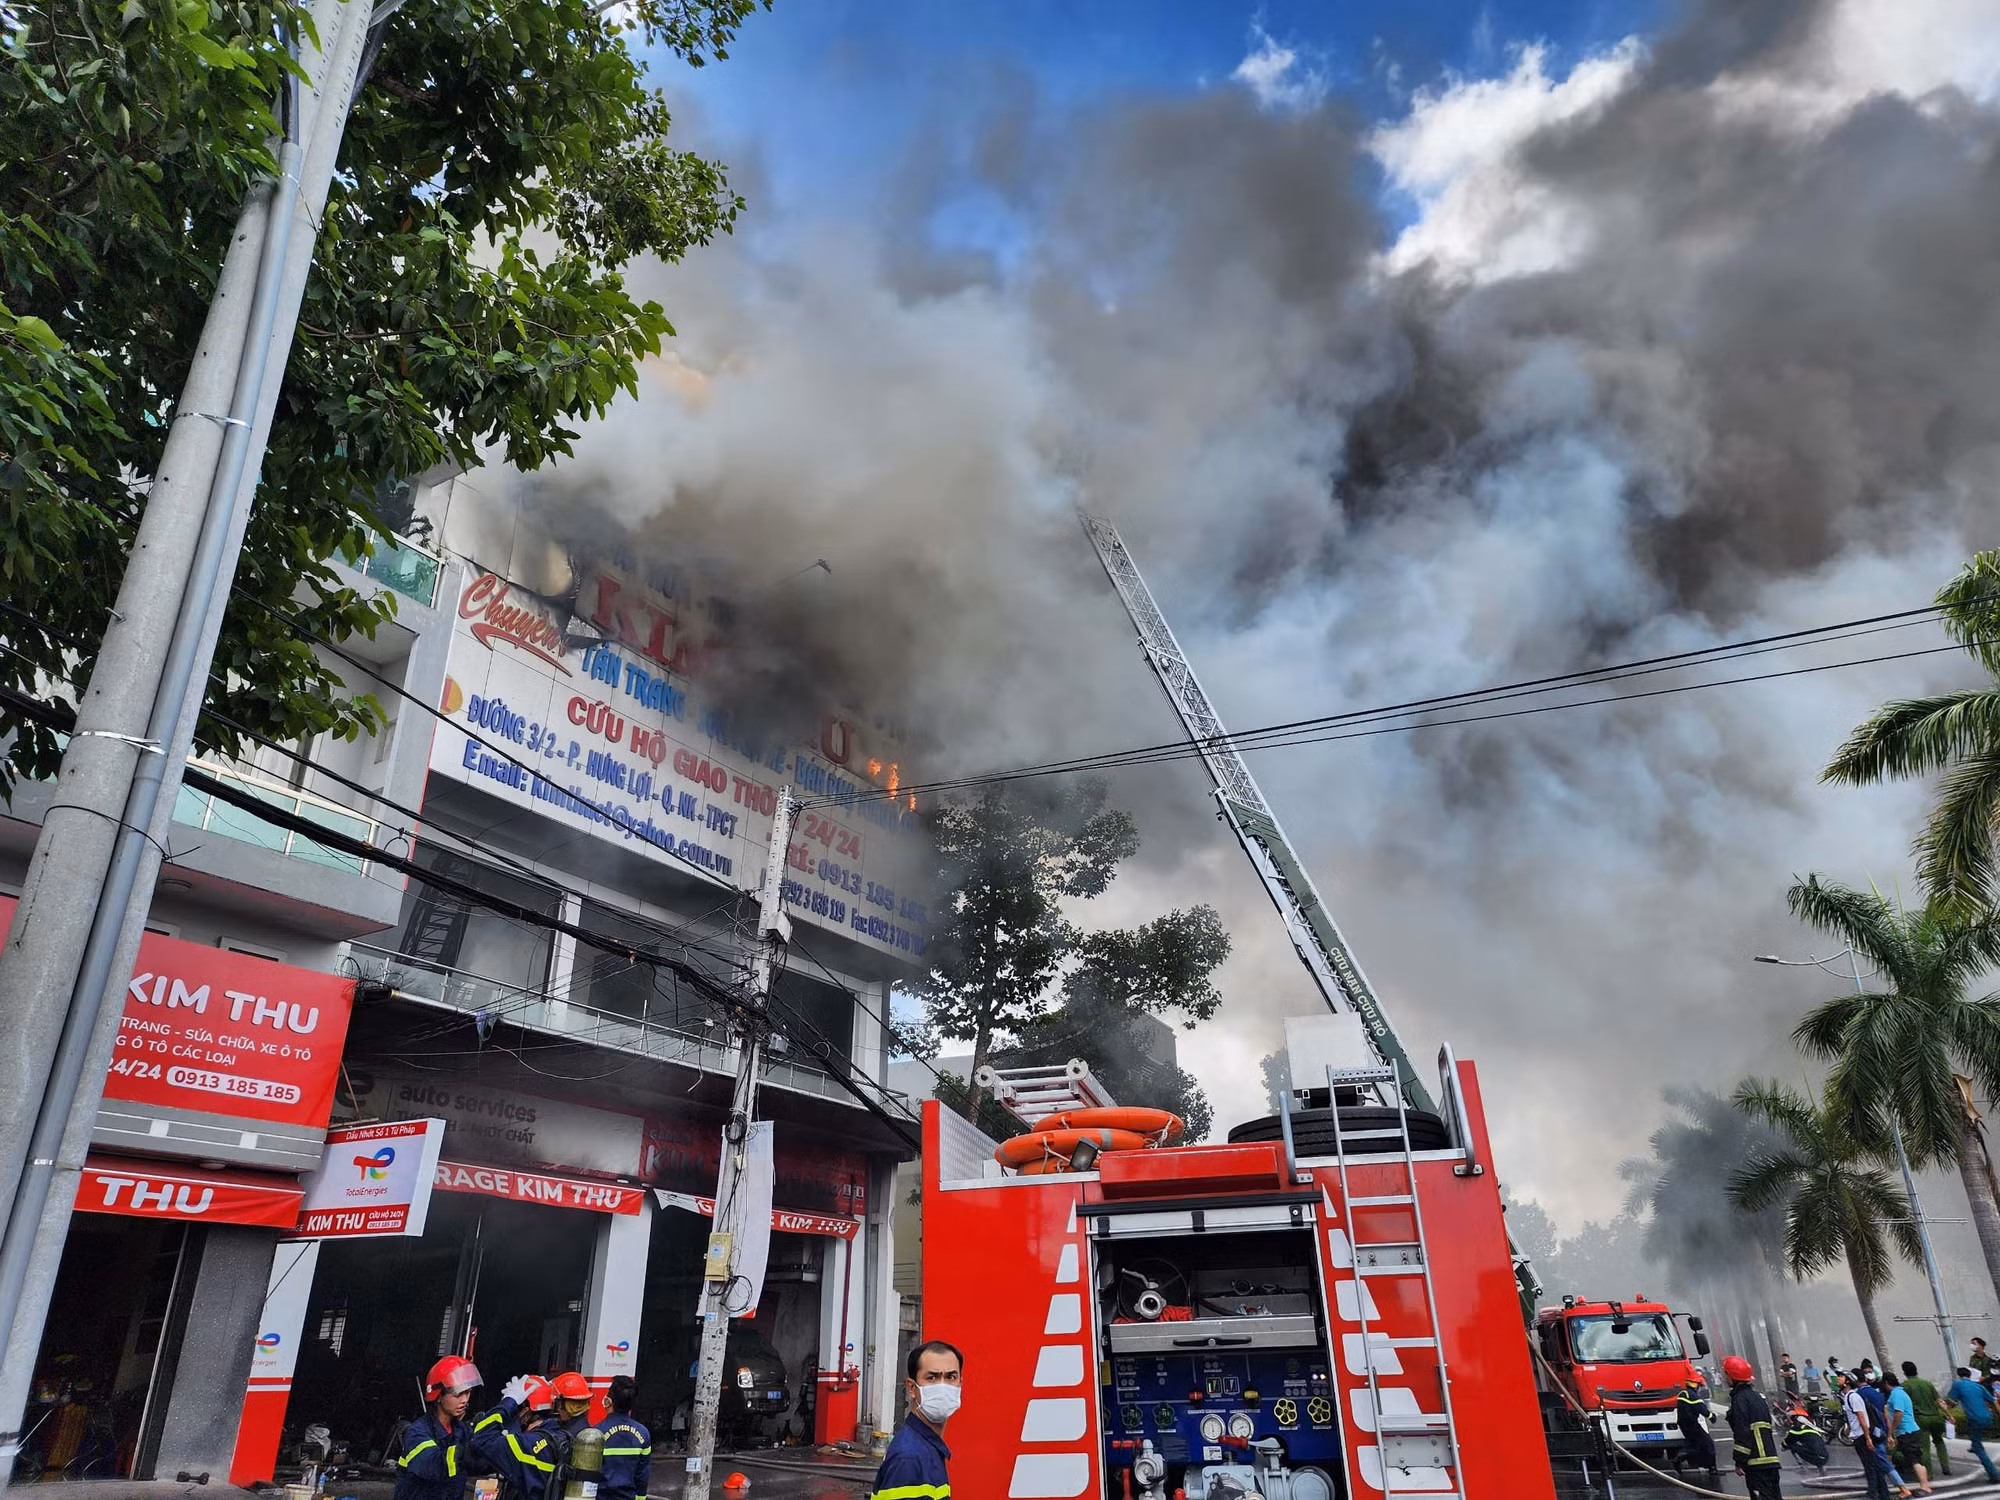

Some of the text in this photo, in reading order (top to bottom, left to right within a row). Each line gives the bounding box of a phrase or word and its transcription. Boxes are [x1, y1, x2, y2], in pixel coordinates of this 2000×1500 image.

[567, 696, 624, 743] CỨU
[629, 726, 667, 770] HỘ
[674, 748, 728, 794] GIAO
[463, 739, 529, 792] Email:
[706, 803, 738, 839] TPCT
[818, 858, 862, 896] 0913
[129, 972, 319, 1034] KIM THU
[121, 1016, 171, 1035] TRANG
[260, 1043, 277, 1056] XE
[280, 1046, 291, 1058] Ô
[294, 1047, 312, 1061] TÔ
[131, 1036, 143, 1049] Ô
[148, 1040, 168, 1054] TÔ
[172, 1045, 200, 1060] CÁC
[205, 1051, 237, 1067] LOẠI
[174, 1070, 219, 1089] 0913
[226, 1078, 258, 1096] 185
[263, 1085, 295, 1102] 185
[400, 1083, 450, 1107] auto
[454, 1092, 537, 1123] services
[97, 1177, 214, 1213] THU
[346, 1186, 388, 1197] TotalEnergies
[517, 1177, 562, 1202] KIM
[571, 1185, 622, 1208] THU
[307, 1215, 333, 1231] KIM
[336, 1213, 365, 1231] THU
[779, 1215, 812, 1230] KIM
